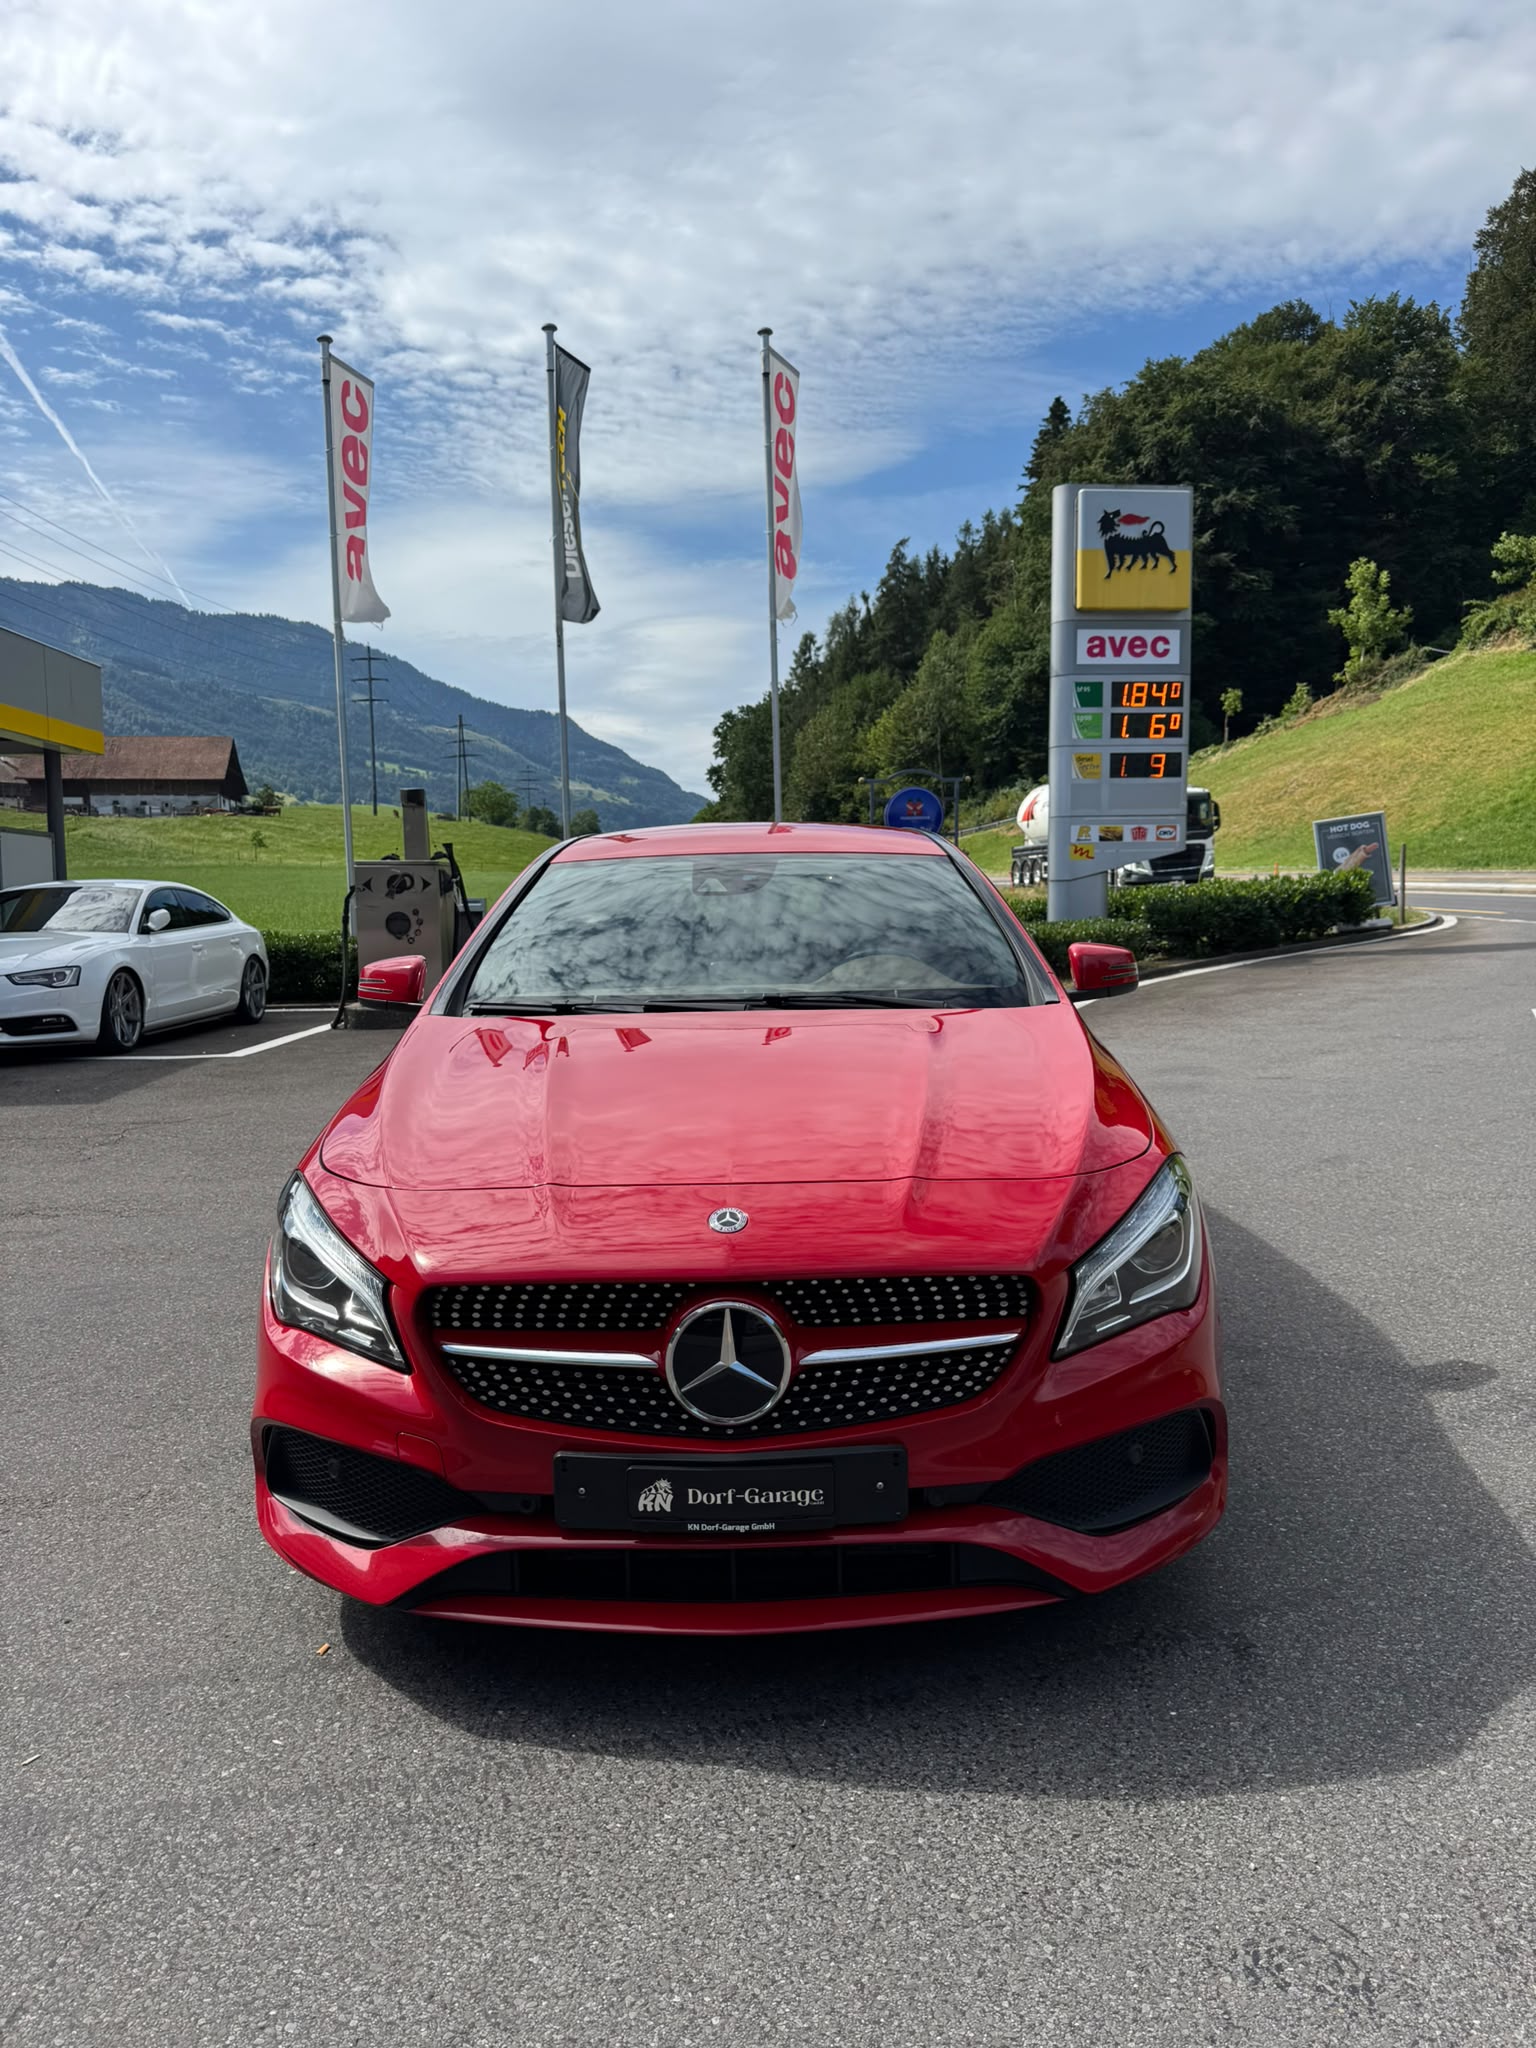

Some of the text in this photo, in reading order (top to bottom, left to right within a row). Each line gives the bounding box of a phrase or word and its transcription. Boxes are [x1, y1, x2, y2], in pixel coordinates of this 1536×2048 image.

[340, 379, 369, 583] avec
[774, 371, 797, 580] avec
[1086, 635, 1170, 658] avec
[1330, 821, 1370, 833] HOT DOG
[688, 1487, 824, 1507] Dorf-Garage
[687, 1522, 775, 1533] KN Dorf-Garage GmbH
